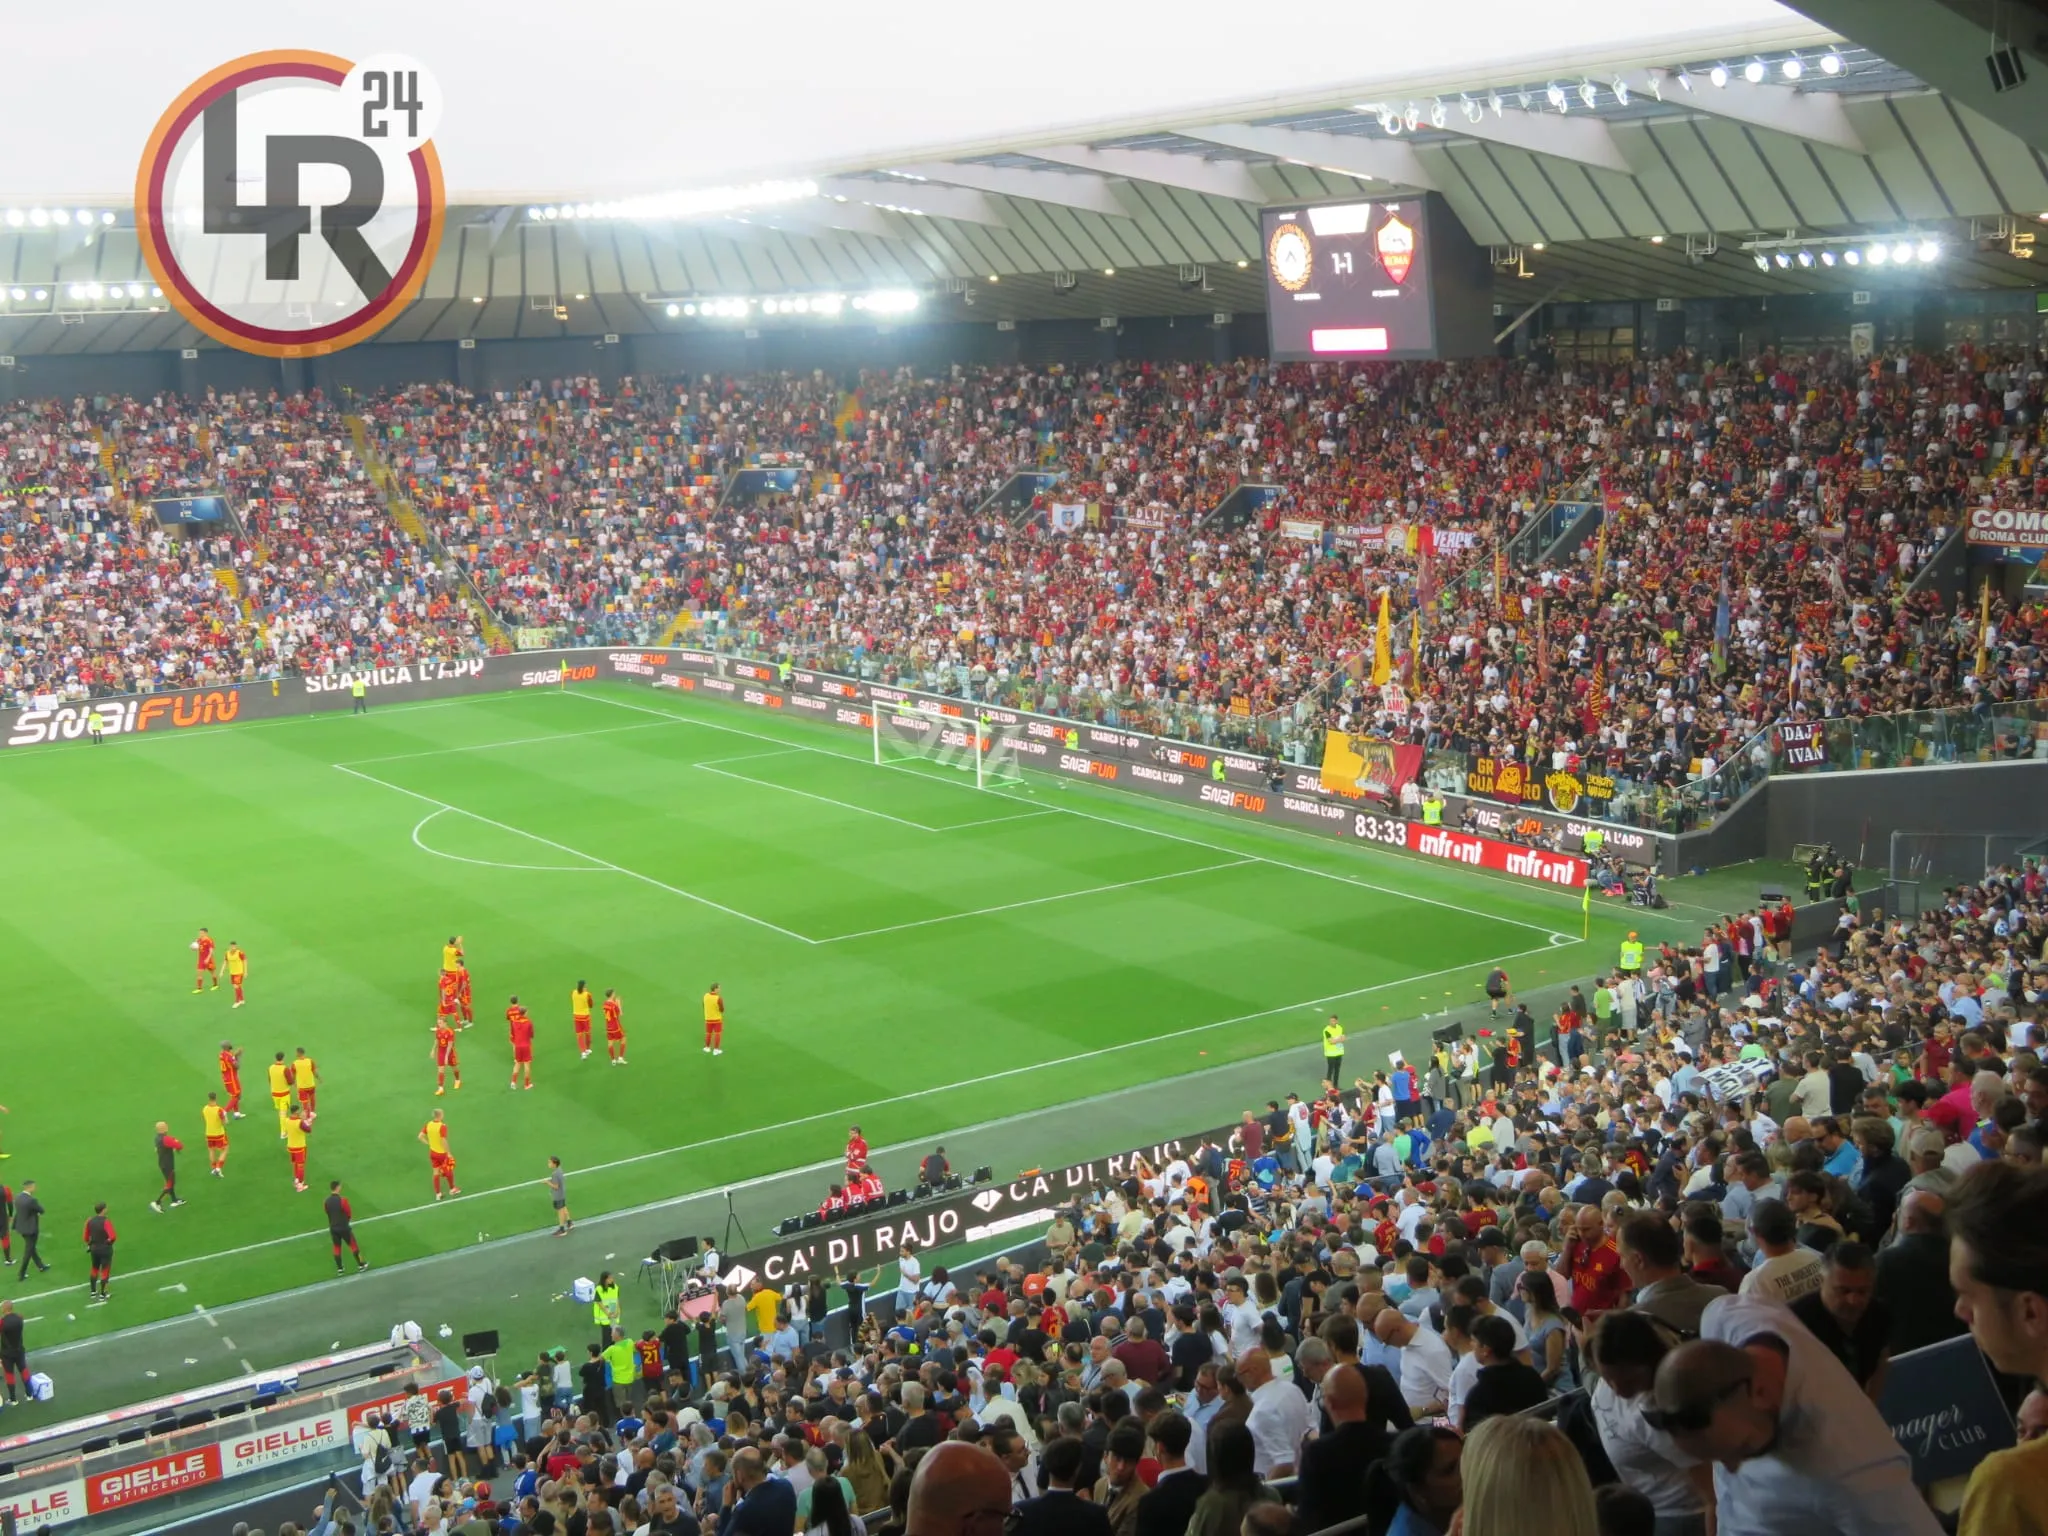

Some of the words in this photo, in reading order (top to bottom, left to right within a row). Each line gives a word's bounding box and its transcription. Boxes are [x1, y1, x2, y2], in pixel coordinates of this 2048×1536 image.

[1980, 530, 2016, 542] ROMA
[305, 667, 413, 694] SCARICA
[822, 681, 857, 699] SNAIFU
[1028, 722, 1068, 741] SNAIFU
[1090, 730, 1119, 745] SCARICA
[1784, 724, 1823, 741] DAJ
[1224, 756, 1257, 772] SCARICA
[1788, 745, 1824, 764] IVAN
[1132, 765, 1162, 781] SCARICA
[1162, 771, 1184, 785] L'APP
[1200, 784, 1265, 812] SNAIFUN
[1283, 797, 1320, 815] SCARICA
[1320, 805, 1345, 820] L'APP
[1354, 813, 1407, 846] 83:33
[1567, 822, 1612, 842] SCACA
[1614, 832, 1644, 849] L'APP
[1010, 1174, 1054, 1200] CA'
[1066, 1163, 1093, 1188] DI
[764, 1246, 816, 1280] CA'
[829, 1234, 859, 1264] DI
[876, 1209, 959, 1252] RAJO
[643, 1349, 658, 1364] 21
[234, 1419, 333, 1459] GIELLE
[1938, 1424, 1986, 1450] CLUB
[236, 1435, 334, 1468] ANTINCENDIO
[100, 1453, 205, 1495] GIELLE
[103, 1470, 207, 1504] ANTINCENDIO
